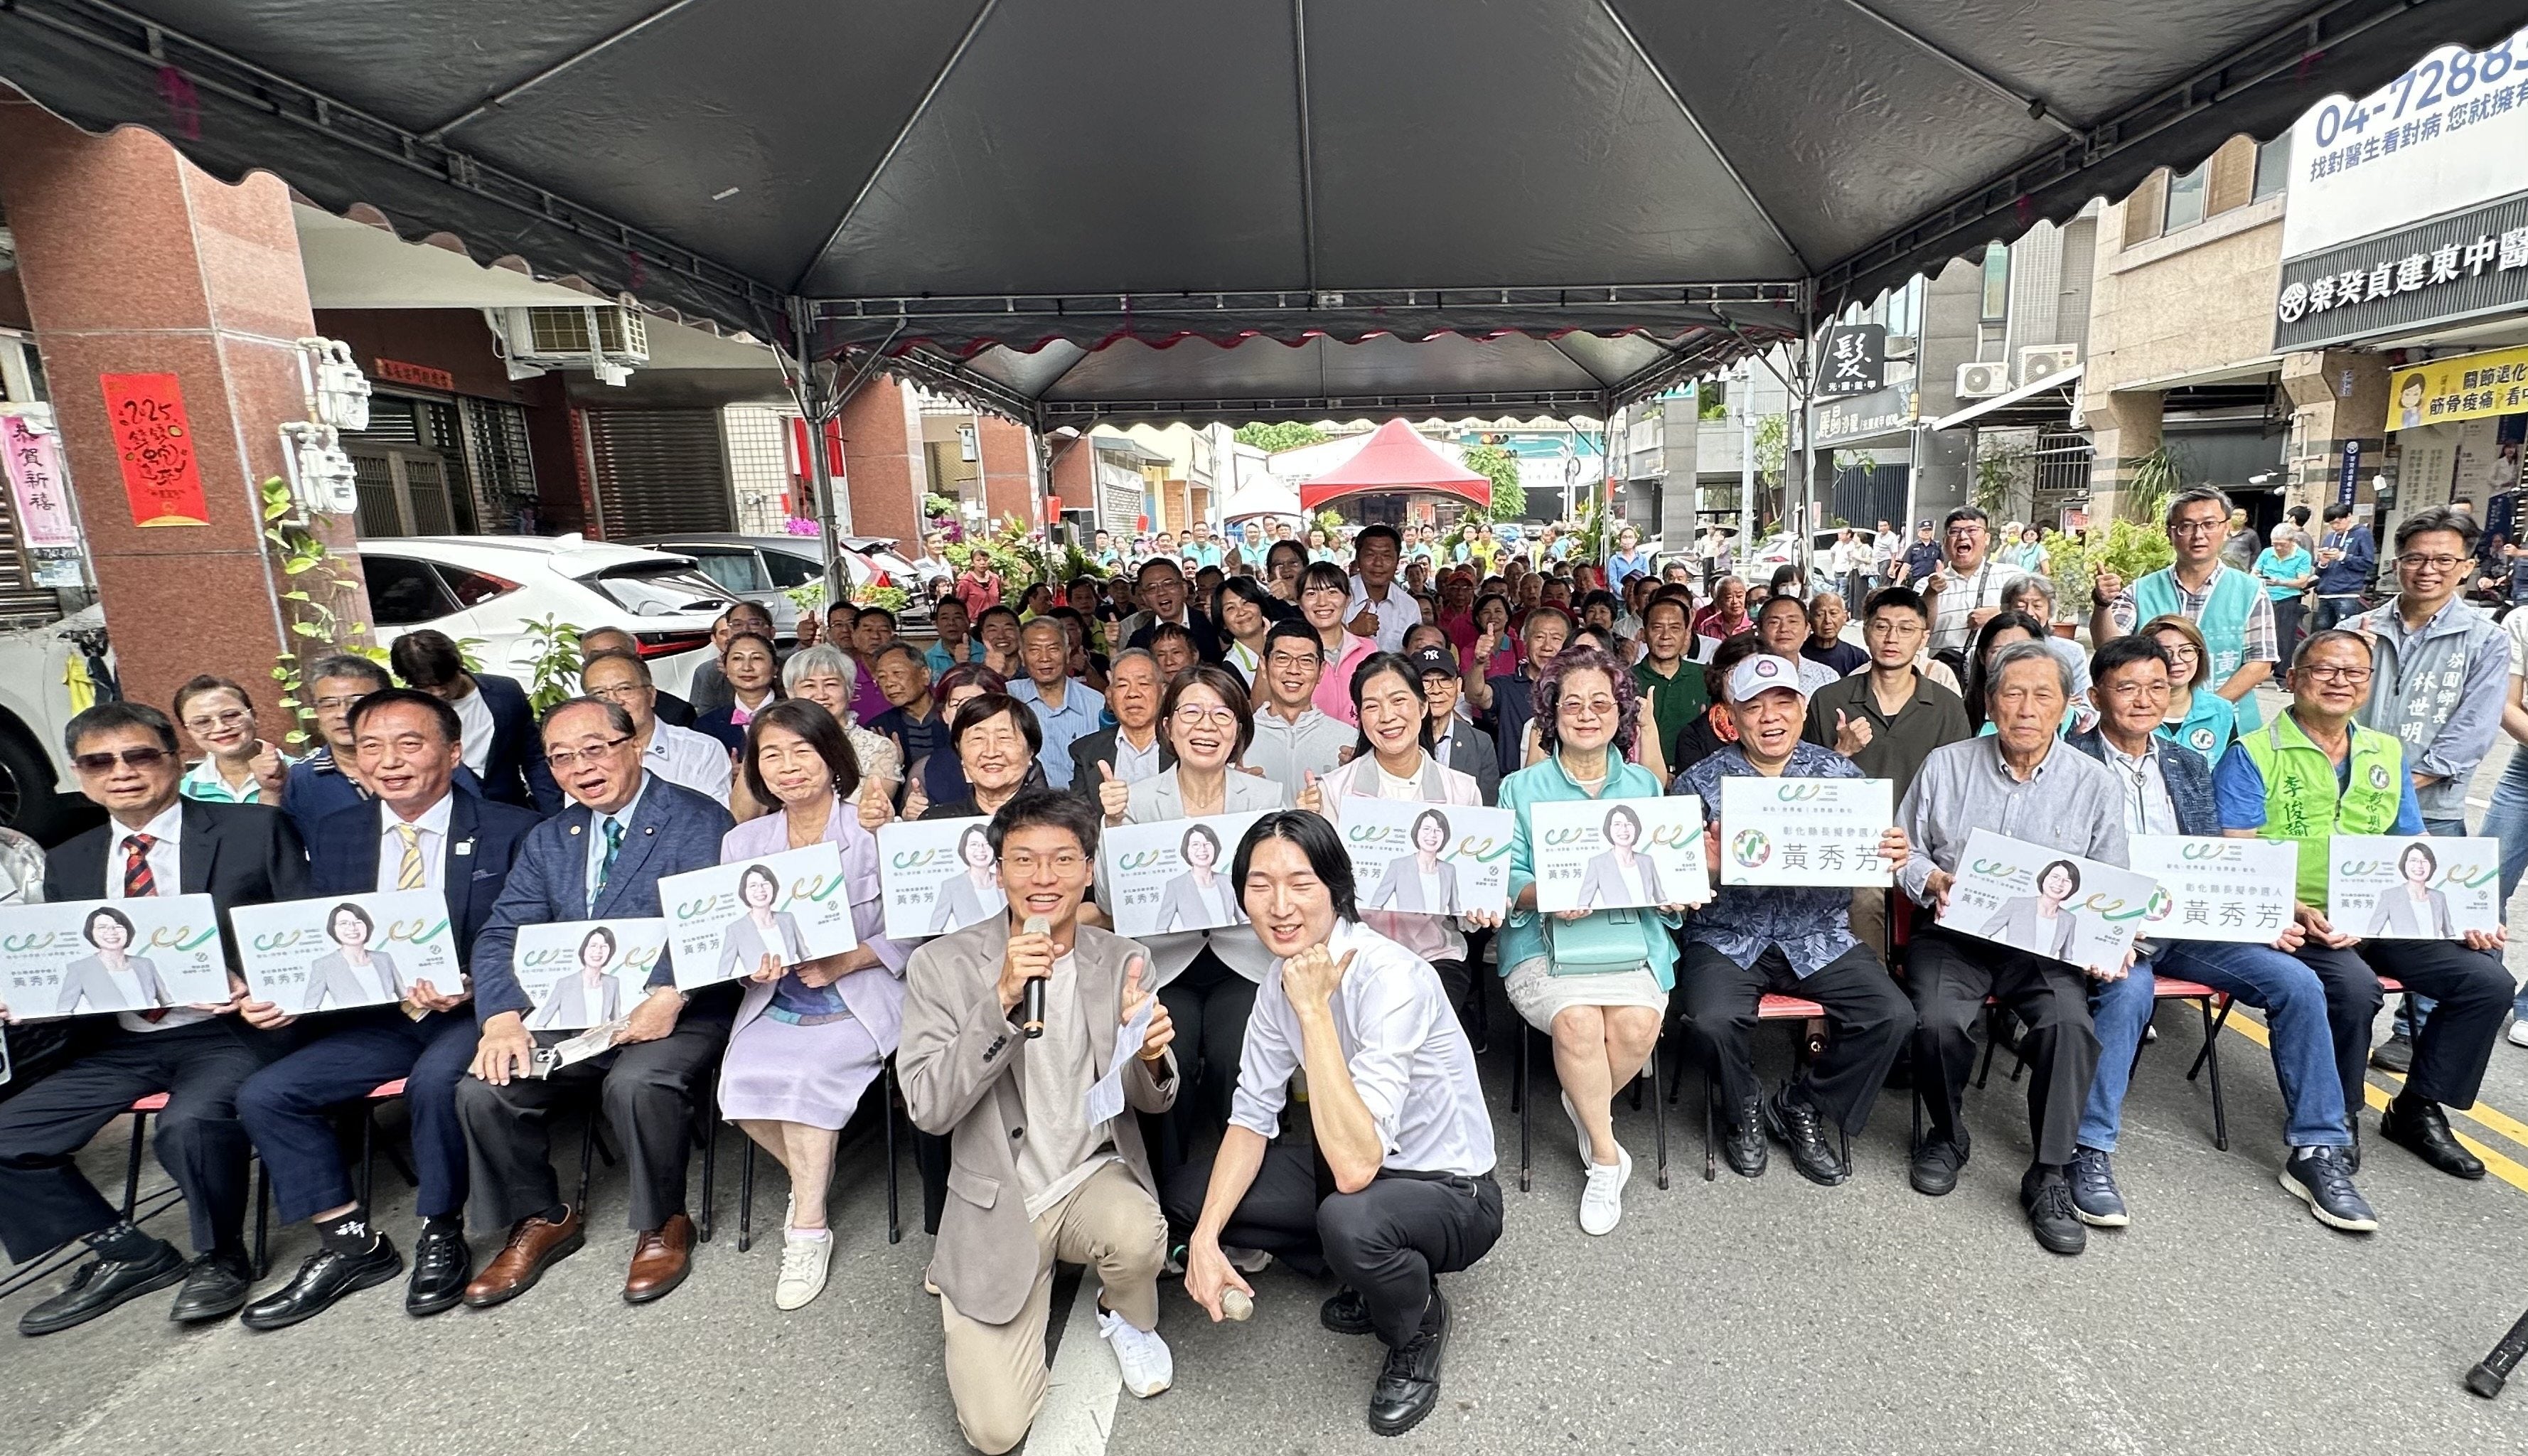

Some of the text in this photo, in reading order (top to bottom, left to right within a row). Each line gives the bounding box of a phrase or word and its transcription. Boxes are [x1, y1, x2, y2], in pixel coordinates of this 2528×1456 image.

[2310, 112, 2443, 182] 找對醫生看對病
[1832, 332, 1872, 378] 髮
[13, 423, 55, 511] 恭賀新禧
[2432, 652, 2465, 724] 芬園鄉長
[2400, 670, 2438, 744] 林世明
[1782, 825, 1880, 838] 彰化縣長擬參選人
[1782, 842, 1879, 871] 黃秀芳
[1352, 867, 1382, 879] 秀芳
[1548, 867, 1582, 879] 黃秀芳
[1124, 892, 1160, 906] 黃秀芳
[1961, 892, 1998, 911] 黃秀芳
[2182, 899, 2283, 929] 黃秀芳
[683, 938, 721, 956] 黃秀芳
